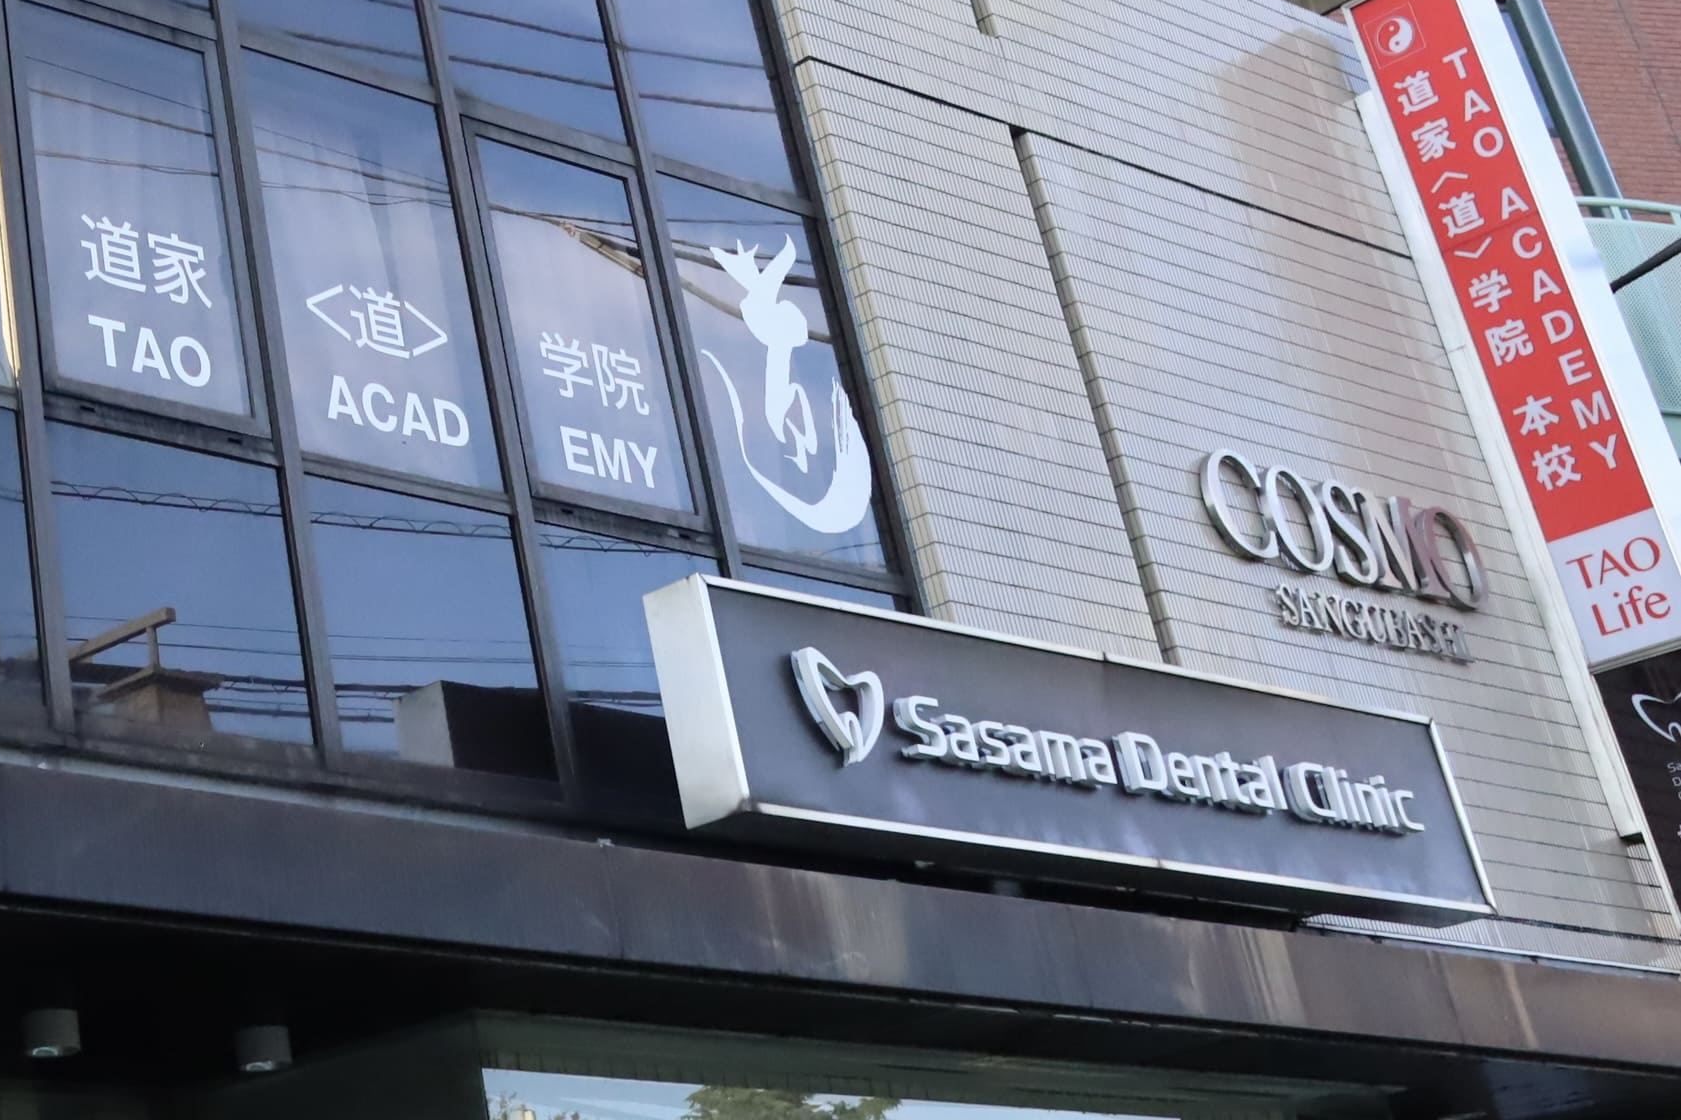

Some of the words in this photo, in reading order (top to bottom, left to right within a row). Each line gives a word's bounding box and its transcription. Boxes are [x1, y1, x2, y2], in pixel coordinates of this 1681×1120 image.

[80, 213, 213, 308] 道家
[539, 330, 651, 417] 学院
[1442, 47, 1504, 158] TAO
[1500, 186, 1619, 472] ACADEMY
[87, 314, 213, 388] TAO
[327, 375, 471, 447] ACAD
[559, 425, 658, 489] EMY
[1199, 446, 1489, 613] COSMO
[1565, 536, 1662, 590] TAO
[1272, 582, 1476, 666] SANGUBASHI
[1591, 584, 1673, 637] Life
[892, 694, 1119, 791] Sasama
[1113, 730, 1289, 815] Dental
[1283, 760, 1427, 836] Clinic
